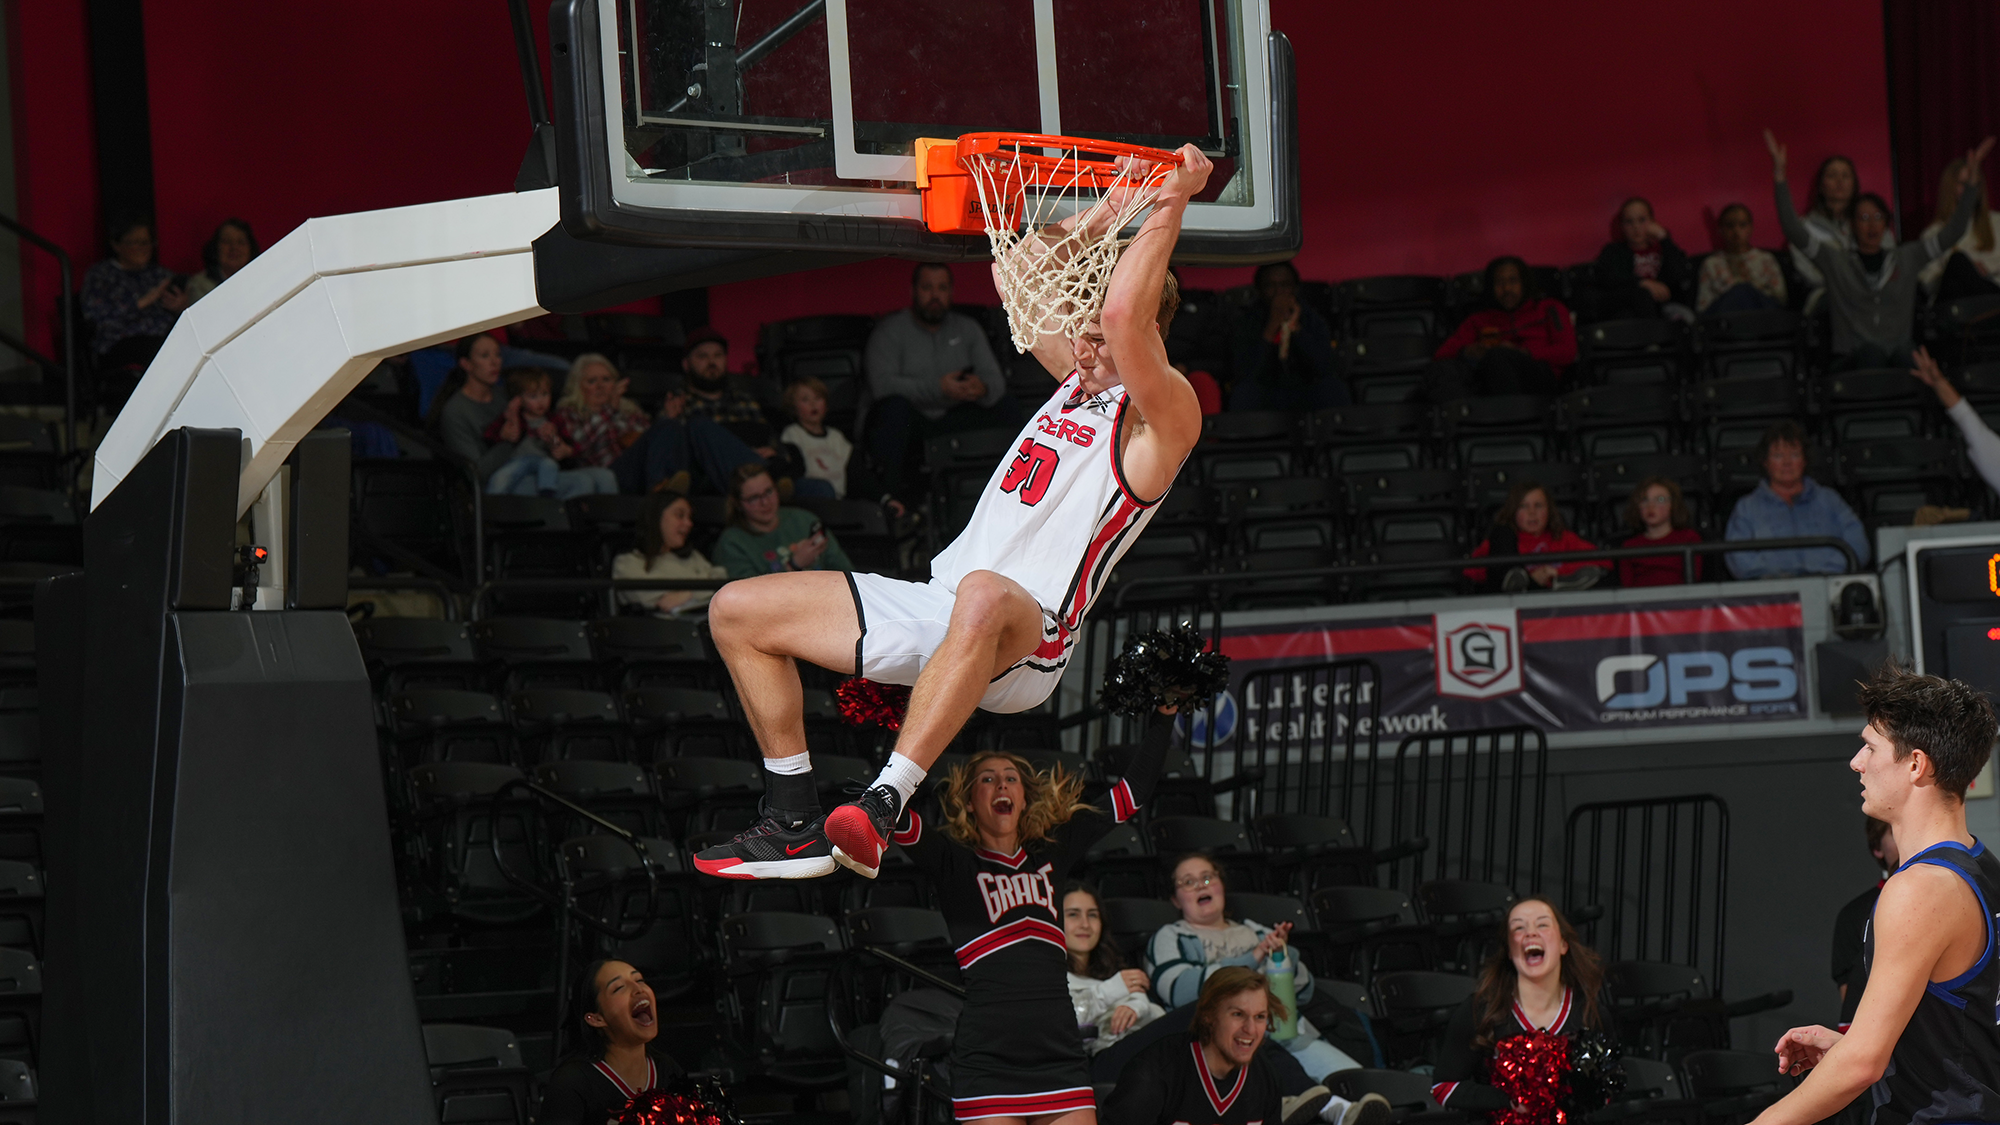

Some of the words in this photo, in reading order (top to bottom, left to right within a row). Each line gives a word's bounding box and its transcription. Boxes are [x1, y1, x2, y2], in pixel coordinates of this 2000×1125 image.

[969, 200, 1015, 216] SPLDG
[1246, 675, 1376, 710] Luhera
[1595, 646, 1799, 709] OPS
[1336, 704, 1448, 738] Nework
[1600, 709, 1657, 723] OPTIMUM
[1659, 704, 1748, 719] PERFORMANCE
[976, 862, 1058, 924] GRACE
